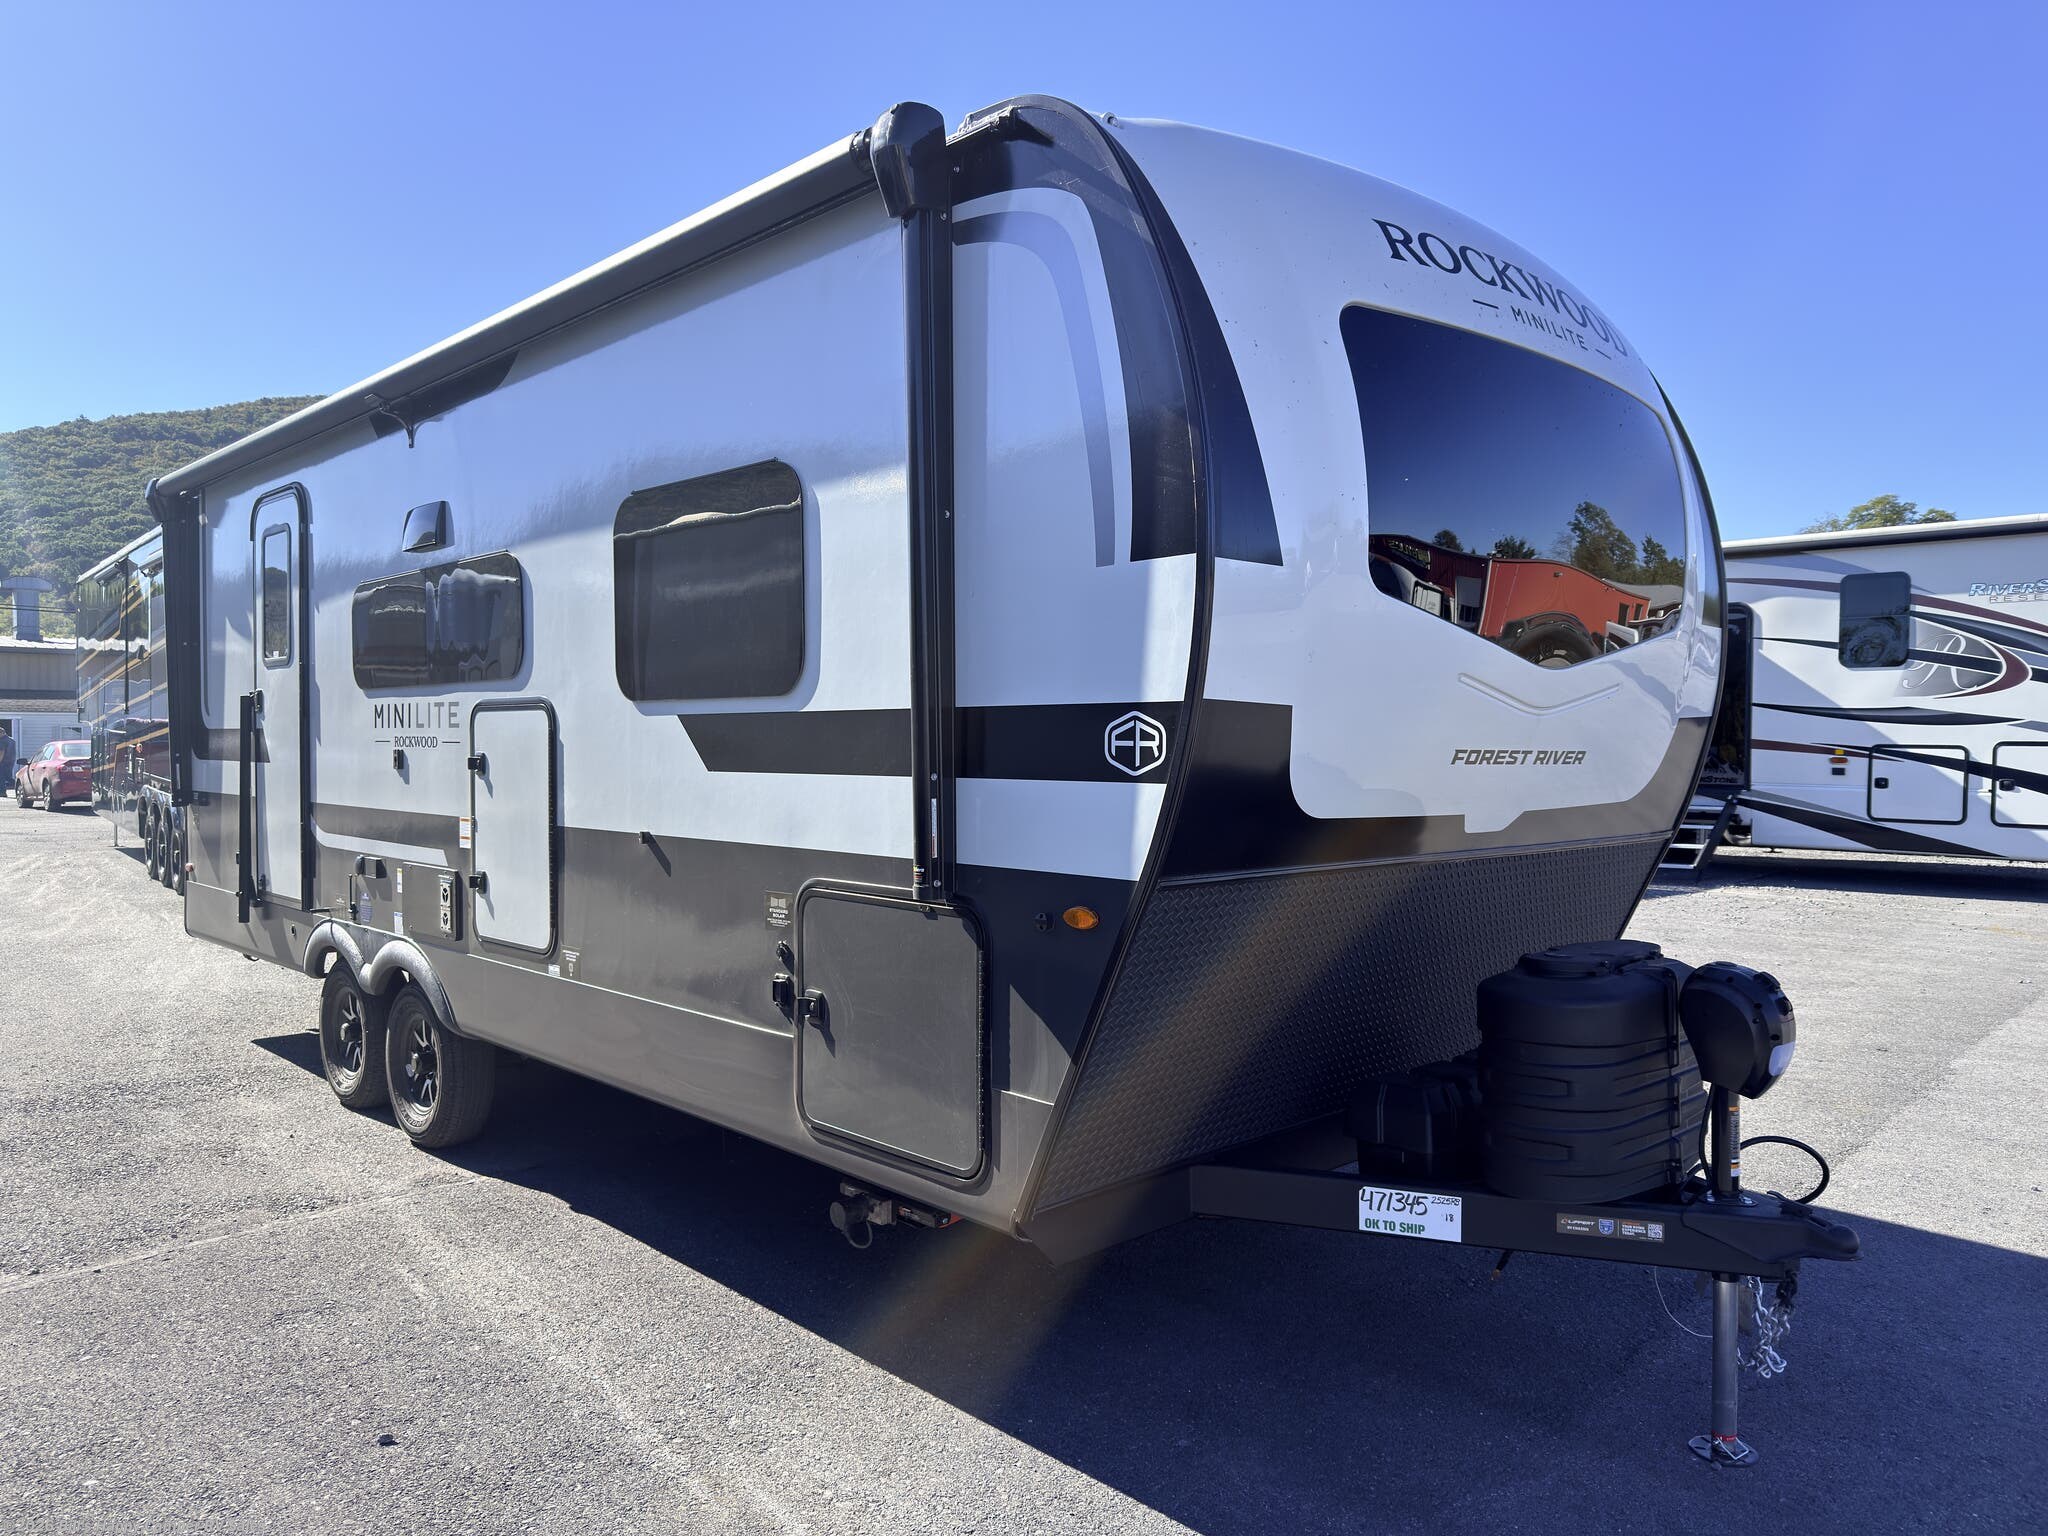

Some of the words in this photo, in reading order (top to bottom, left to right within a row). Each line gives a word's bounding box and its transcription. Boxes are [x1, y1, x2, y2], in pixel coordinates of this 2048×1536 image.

[1371, 218, 1628, 357] ROCKWOOD
[1510, 305, 1589, 351] MINILITE
[374, 702, 460, 729] MINILITE
[394, 735, 438, 748] ROCKWOOD
[1450, 749, 1533, 765] FOREST
[1532, 750, 1587, 765] RIVER
[1361, 1189, 1428, 1216] 471345
[1365, 1218, 1379, 1229] OK
[1383, 1220, 1396, 1231] TO
[1399, 1222, 1425, 1234] SHIP
